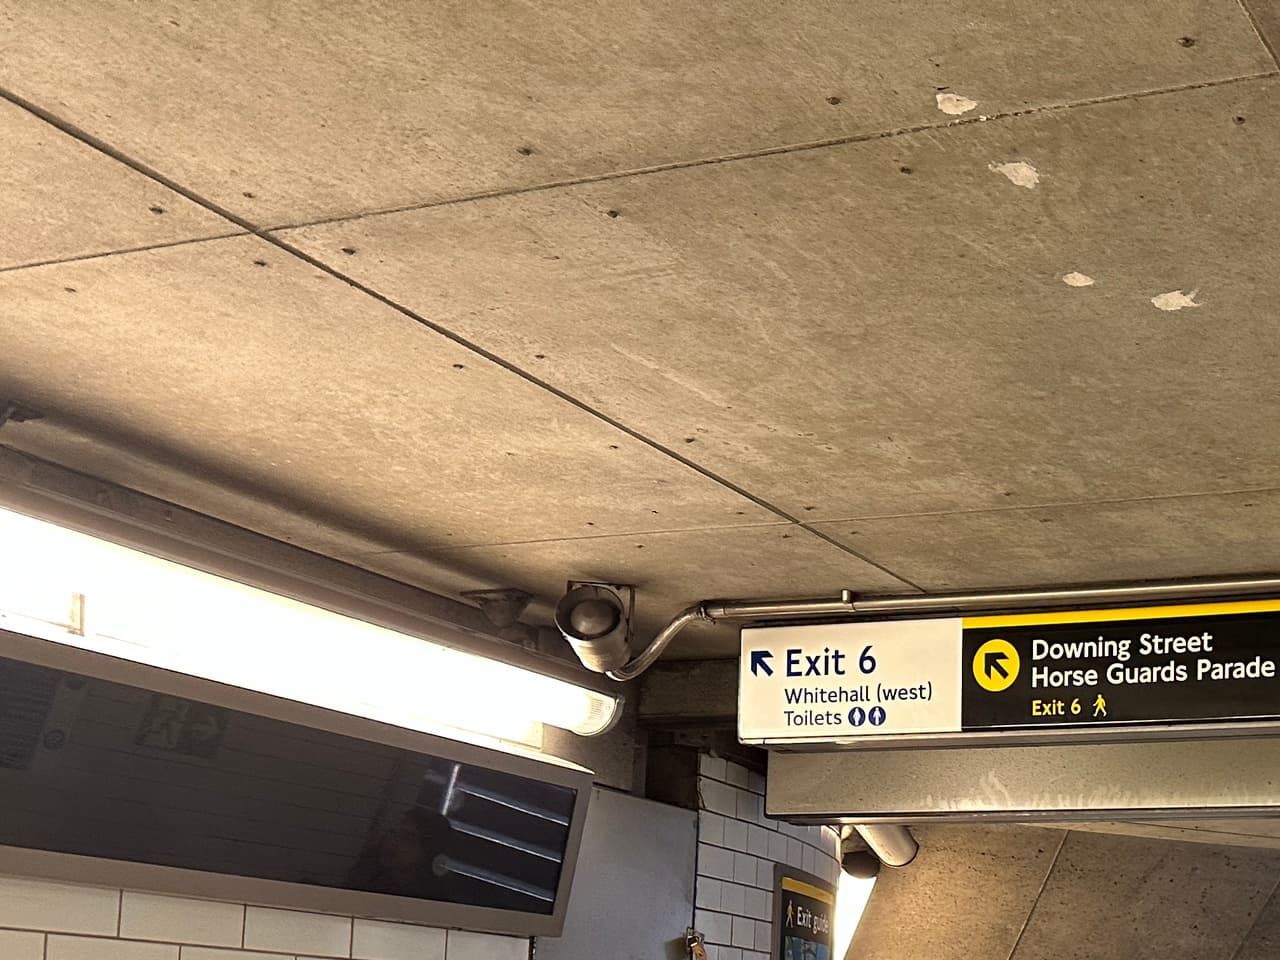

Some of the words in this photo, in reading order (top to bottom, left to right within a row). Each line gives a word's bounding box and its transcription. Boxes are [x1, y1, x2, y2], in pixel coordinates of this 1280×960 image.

[1031, 635, 1130, 661] Downing
[1139, 632, 1213, 656] Street
[785, 647, 846, 678] Exit
[858, 645, 877, 675] 6
[1031, 664, 1099, 688] Horse
[1106, 660, 1188, 685] Guards
[1196, 656, 1276, 681] Parade
[784, 683, 871, 705] Whitehall
[876, 680, 933, 703] (west)
[783, 707, 842, 727] Toilets
[1031, 699, 1066, 717] Exit
[1070, 698, 1082, 716] 6
[797, 906, 812, 929] Exit
[813, 914, 829, 935] guide
